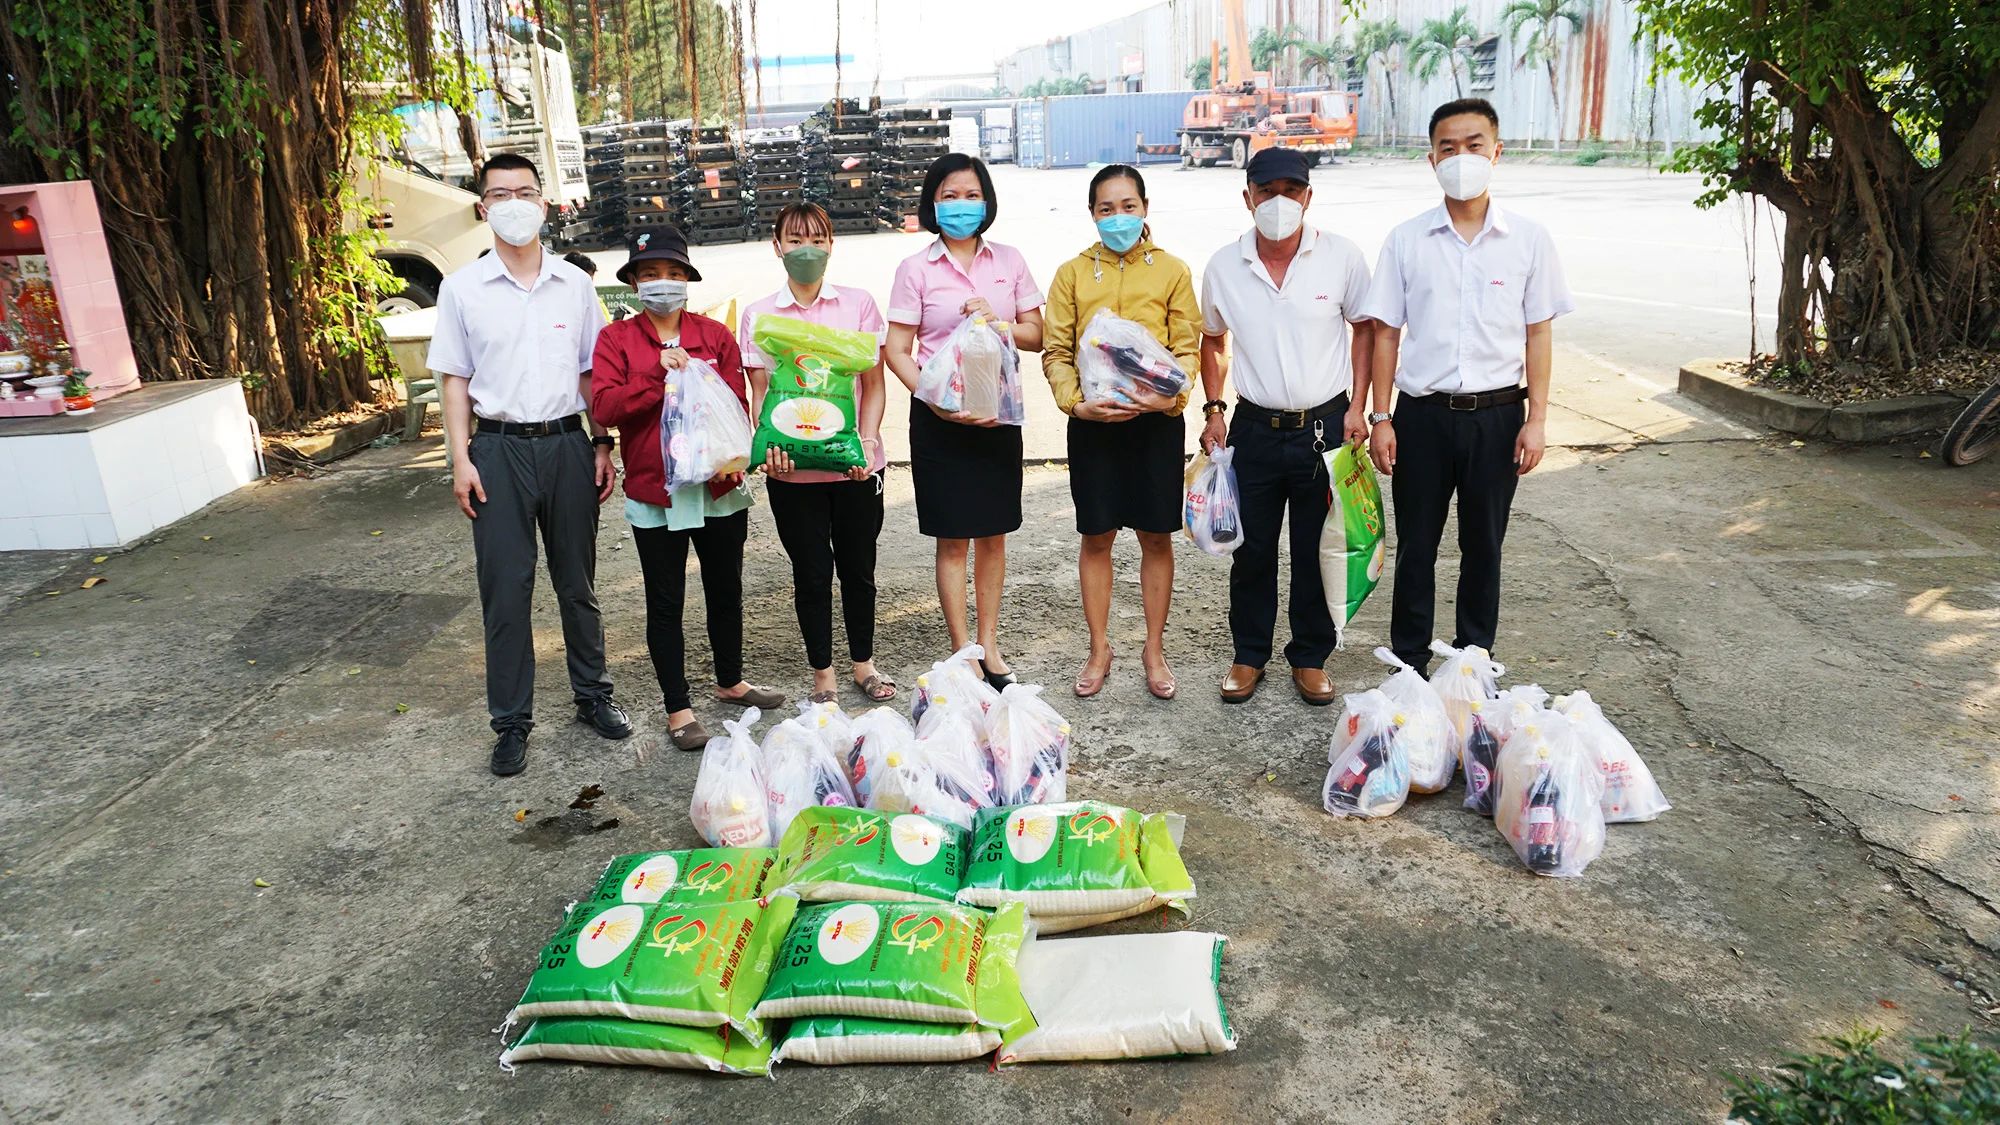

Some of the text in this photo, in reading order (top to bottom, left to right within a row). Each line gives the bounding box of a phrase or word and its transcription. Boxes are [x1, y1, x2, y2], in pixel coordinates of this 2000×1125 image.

[987, 841, 1003, 862] 25
[547, 944, 571, 969] 25
[792, 945, 812, 967] 25
